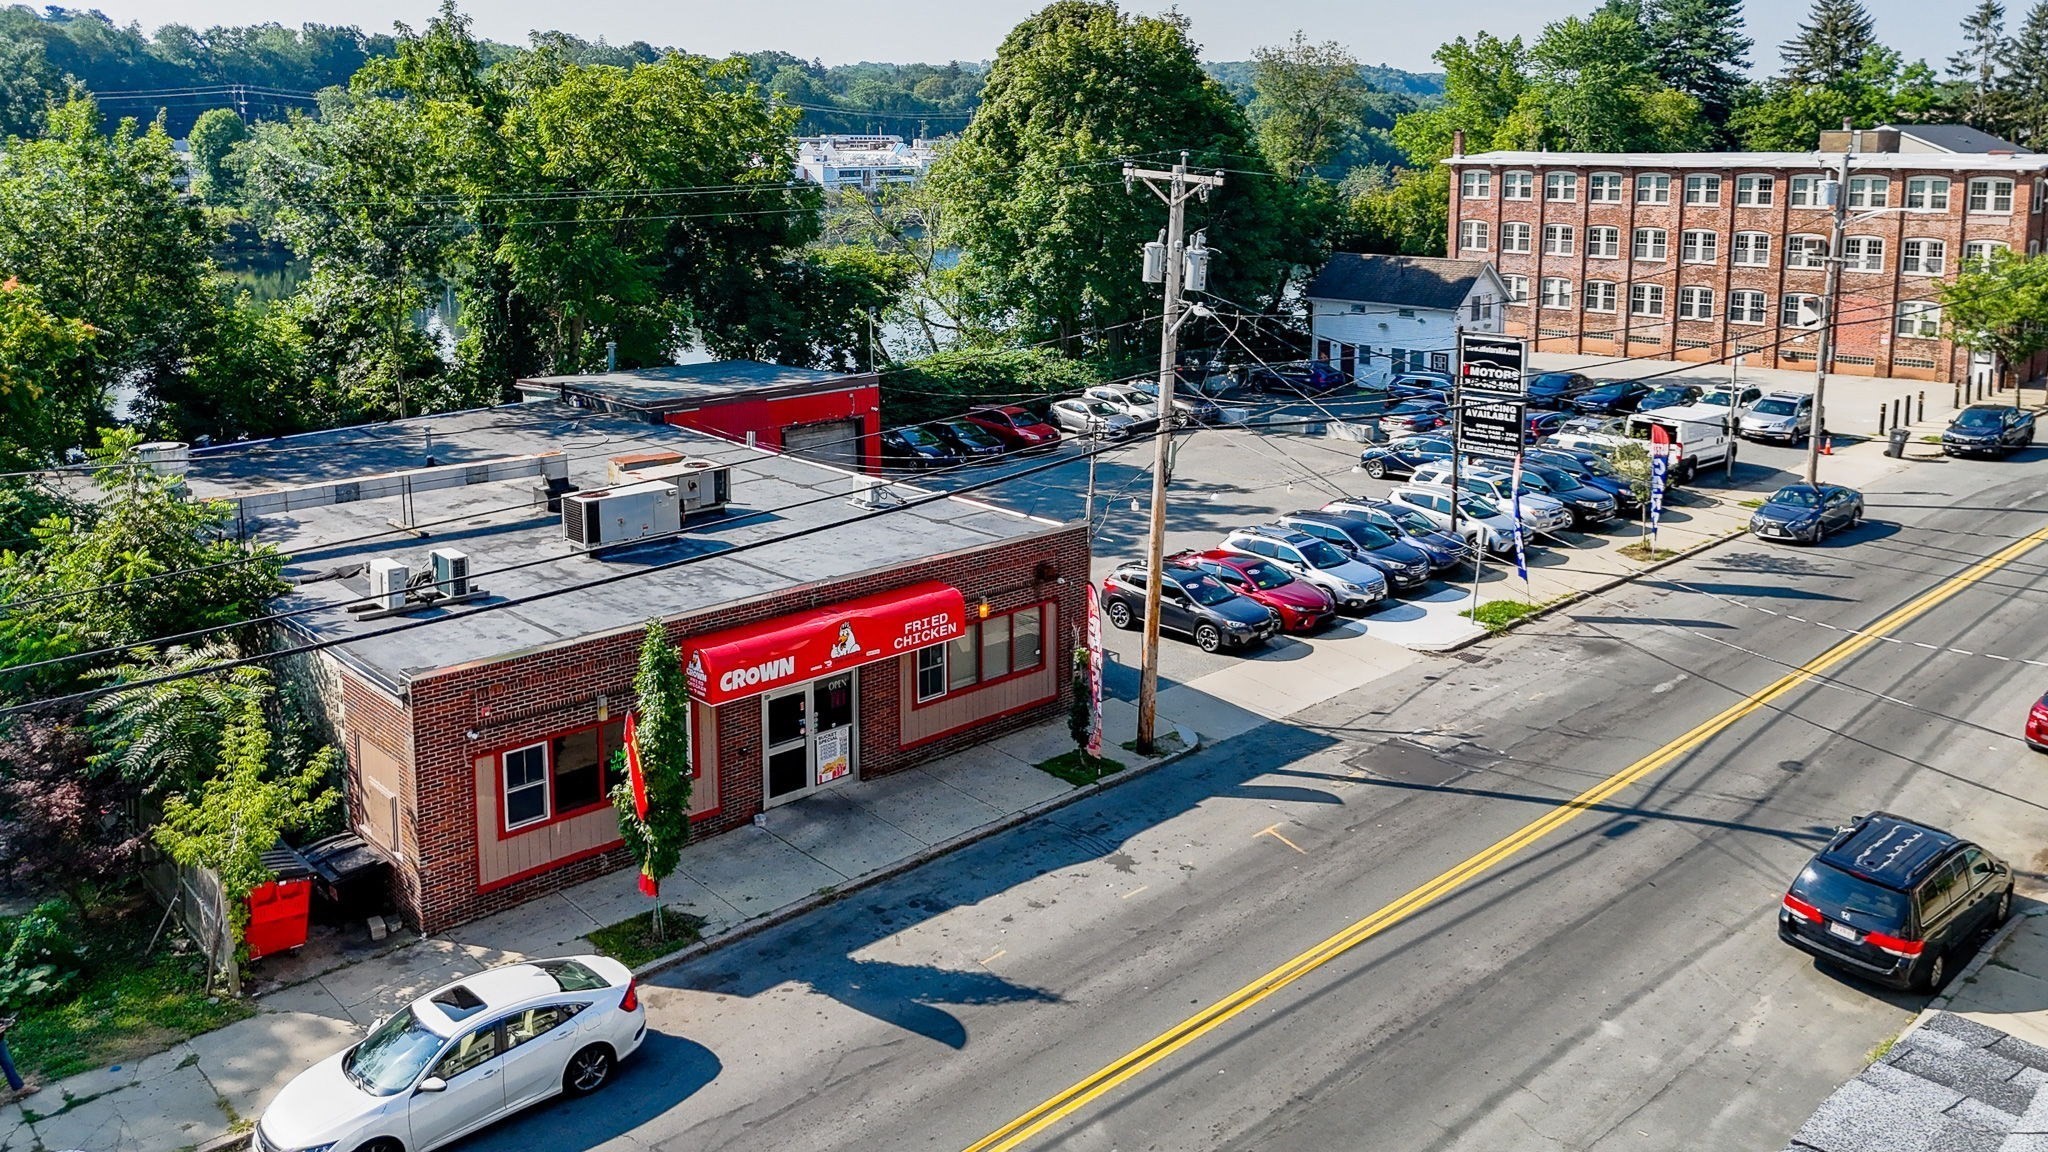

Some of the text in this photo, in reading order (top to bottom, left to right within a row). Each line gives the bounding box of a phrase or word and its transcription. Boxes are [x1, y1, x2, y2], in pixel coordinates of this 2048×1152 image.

[1465, 408, 1517, 422] AVAILABLE
[904, 612, 949, 635] FRIED
[893, 622, 957, 650] CHICKEN
[719, 655, 795, 692] CROWN
[828, 679, 847, 691] OPEN
